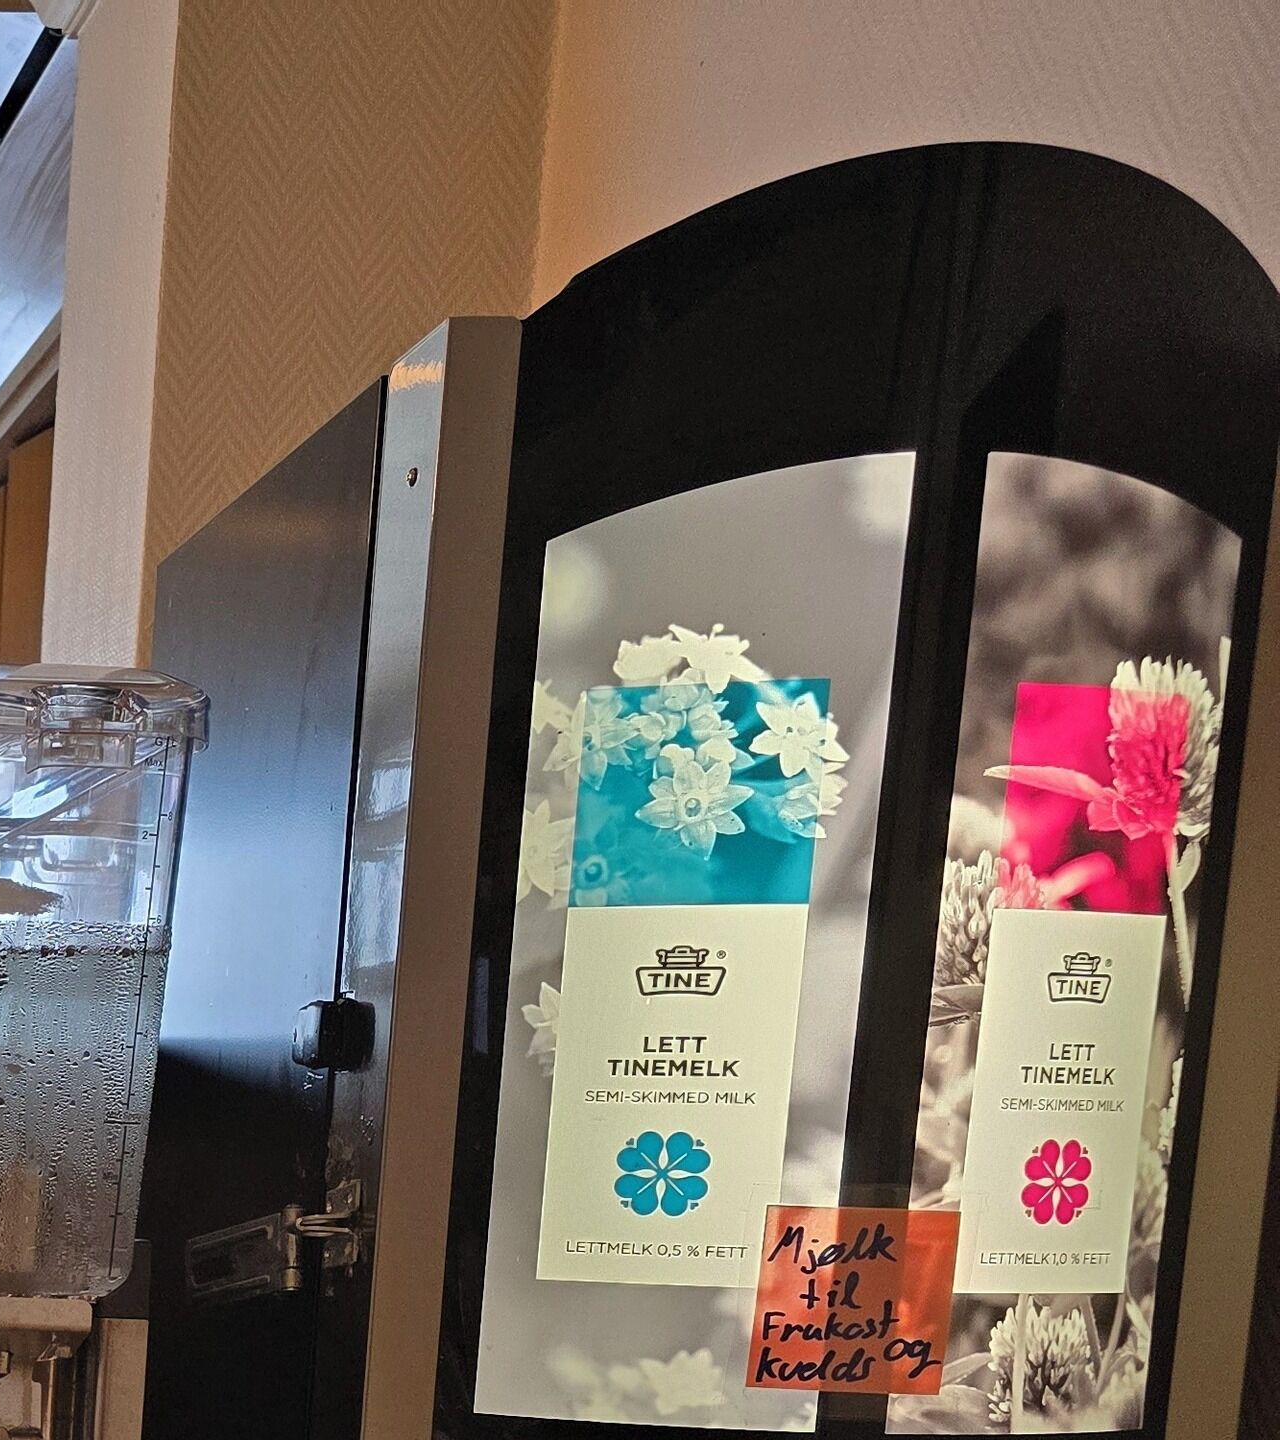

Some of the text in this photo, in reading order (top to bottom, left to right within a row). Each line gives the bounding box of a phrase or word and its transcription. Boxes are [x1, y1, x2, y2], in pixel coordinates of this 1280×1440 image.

[646, 973, 712, 989] TINE
[1055, 979, 1102, 996] TINE
[642, 1036, 707, 1053] LETT
[1049, 1043, 1096, 1061] LETT
[607, 1059, 740, 1077] TINEMELK
[1021, 1066, 1116, 1086] TINEMELK
[584, 1090, 756, 1106] SEMI-SKIMMED MILK
[1000, 1097, 1125, 1113] SEMI-SKIMMED MILK
[566, 1240, 749, 1259] LETTMELK 0,5 % FETT
[980, 1252, 1051, 1265] LETTMELK
[1071, 1252, 1080, 1265] %
[1083, 1252, 1111, 1265] FETT
[799, 1271, 862, 1310] til
[883, 1338, 942, 1379] og
